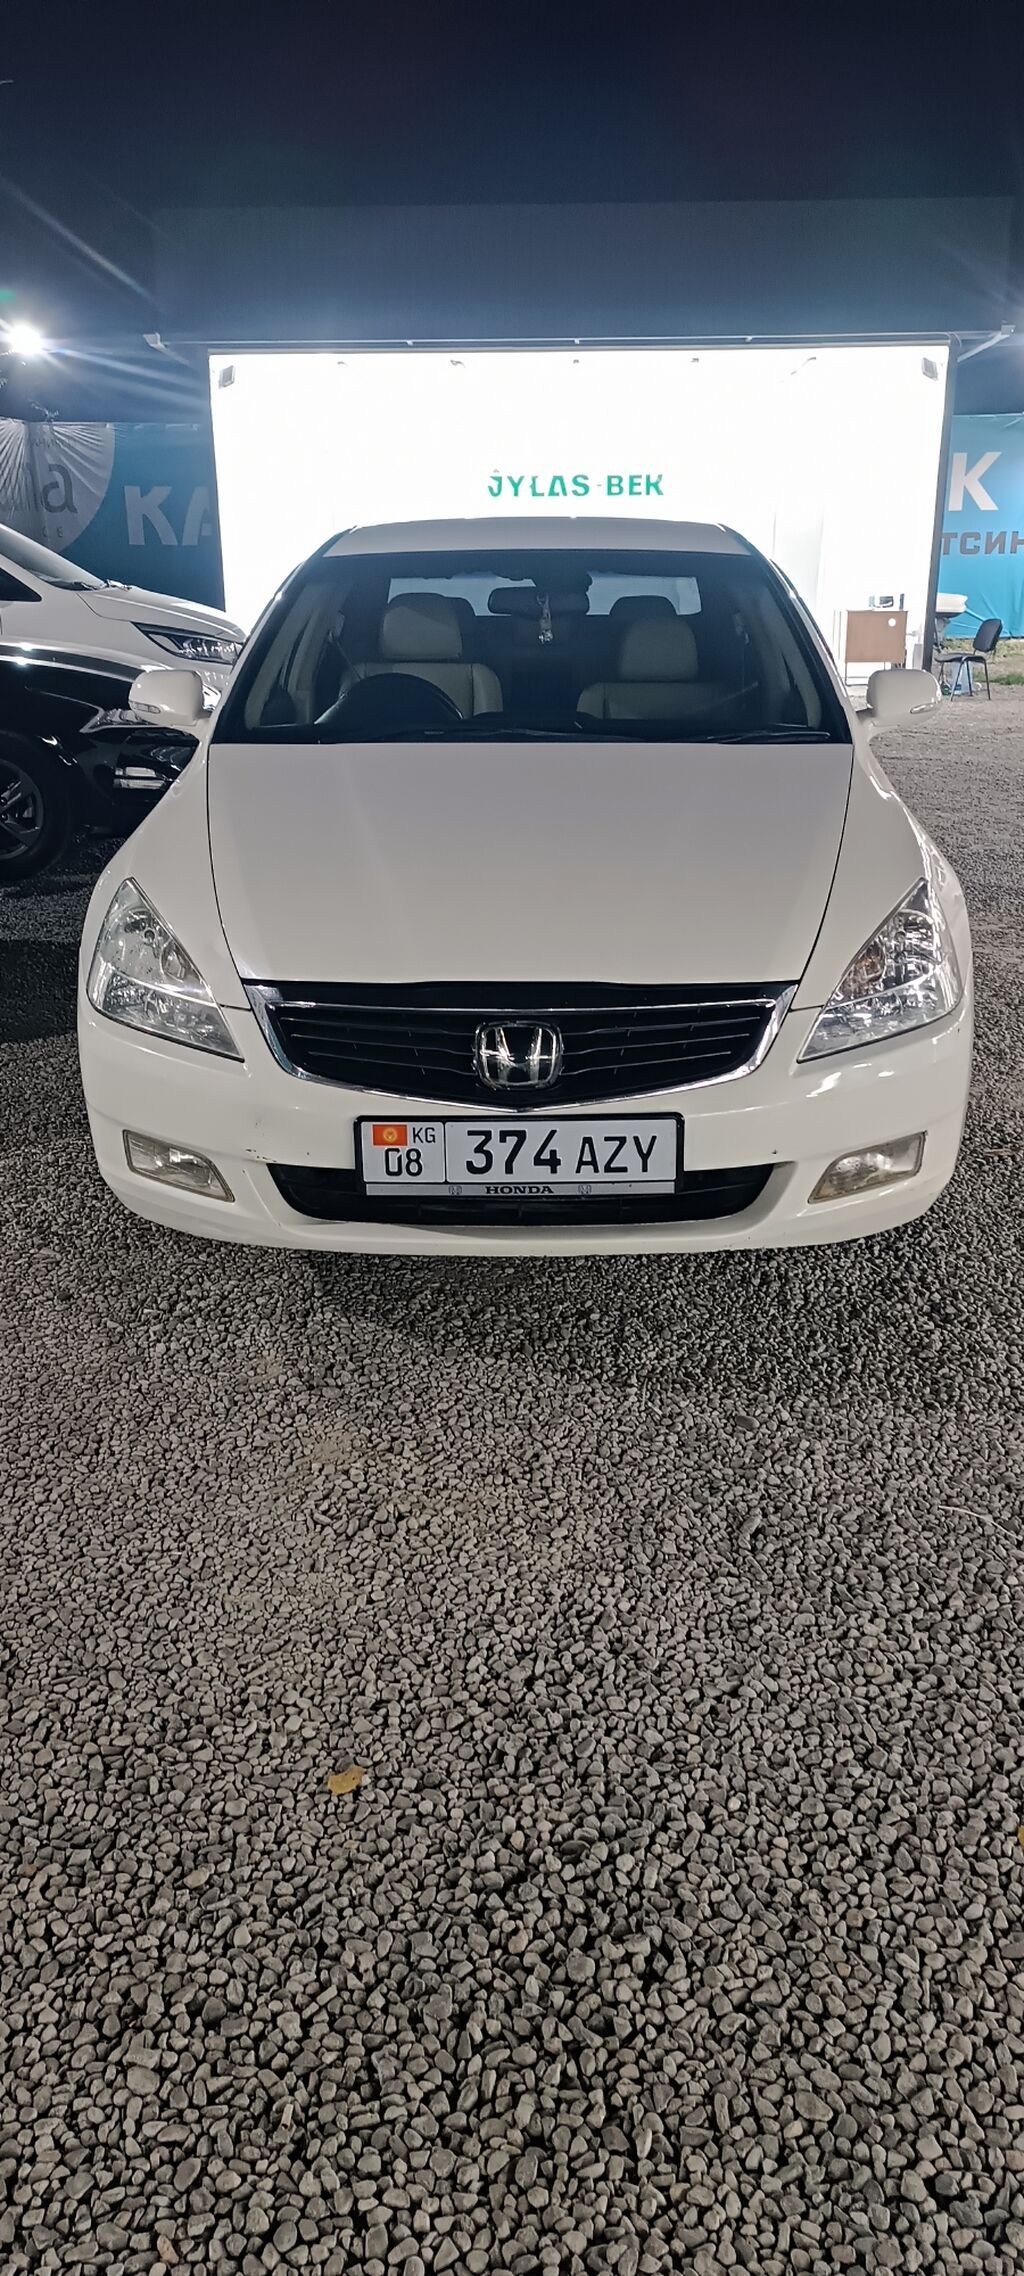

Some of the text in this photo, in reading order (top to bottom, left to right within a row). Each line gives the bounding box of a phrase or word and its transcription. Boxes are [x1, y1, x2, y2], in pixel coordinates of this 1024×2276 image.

[412, 1127, 436, 1143] KG
[384, 1148, 423, 1177] 08
[465, 1129, 657, 1175] 374 AZY
[485, 1185, 554, 1195] HONDA
